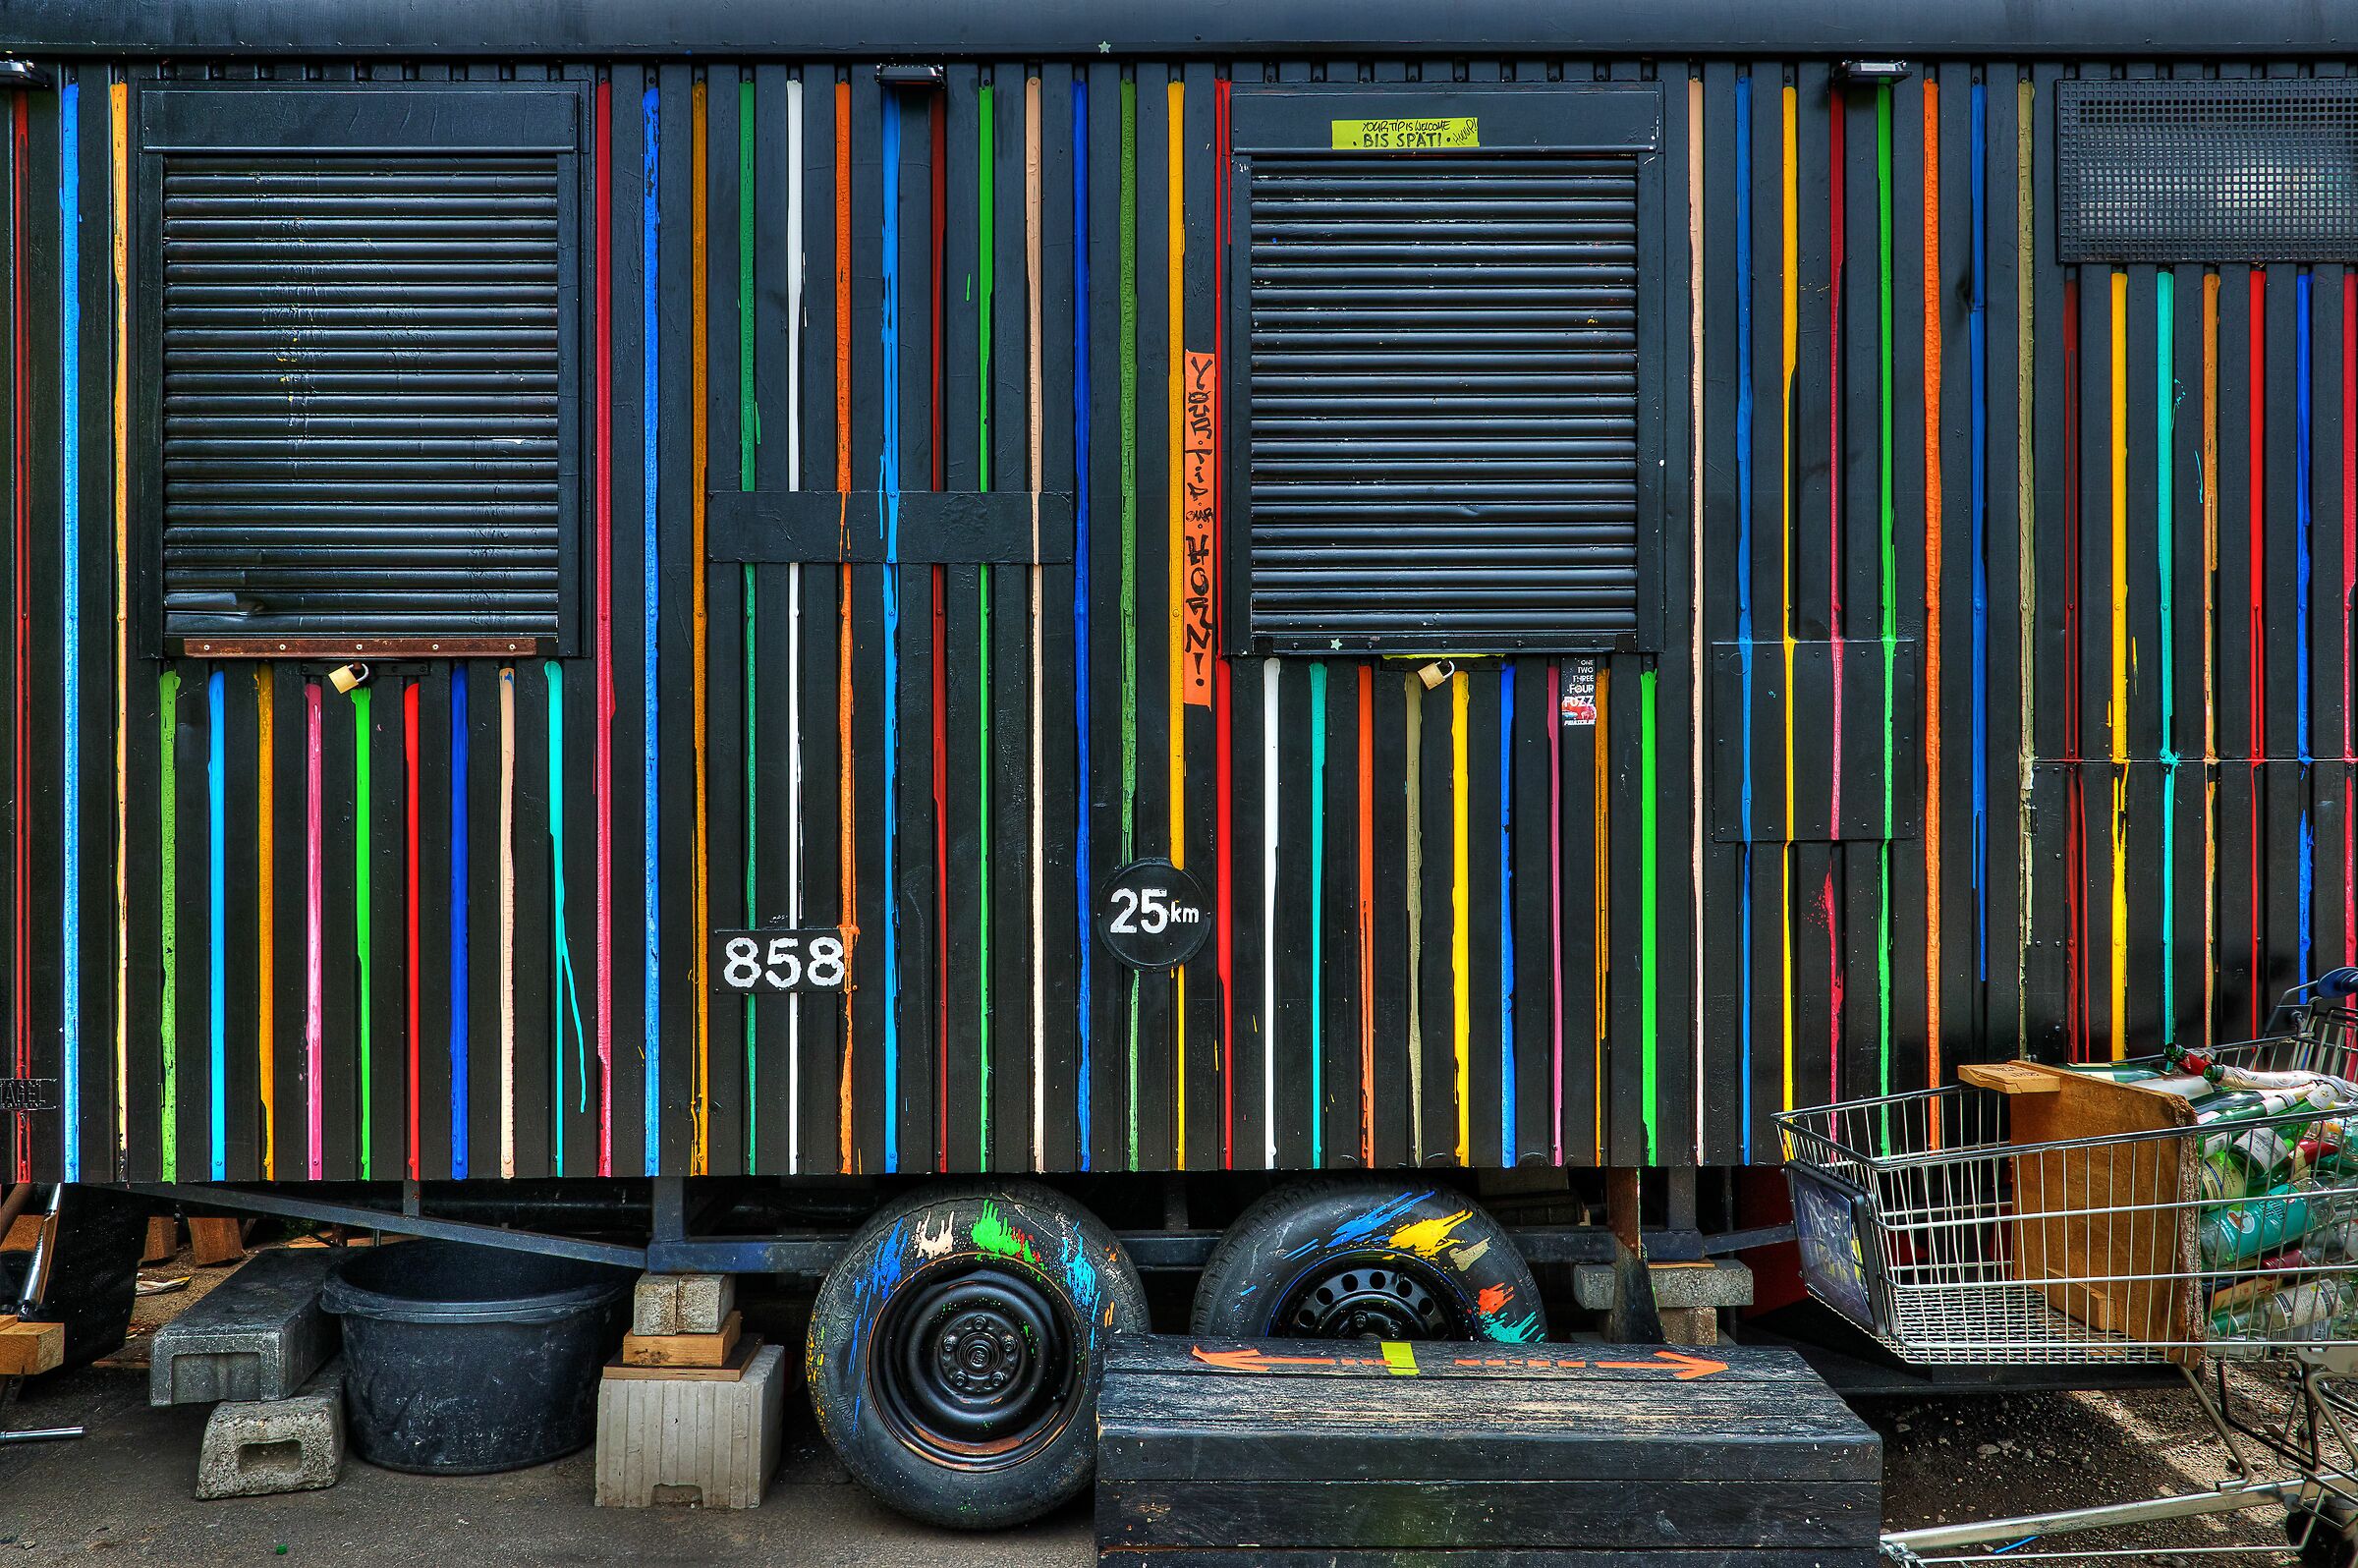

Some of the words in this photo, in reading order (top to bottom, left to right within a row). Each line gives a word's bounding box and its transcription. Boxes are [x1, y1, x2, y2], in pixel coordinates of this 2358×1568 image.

[1362, 121, 1389, 133] YOUR
[1389, 119, 1405, 132] TIP
[1405, 122, 1414, 132] IS
[1415, 120, 1451, 132] WELCOME
[1363, 133, 1389, 147] BIS
[1569, 684, 1595, 694] FOUR
[723, 936, 845, 988] 858
